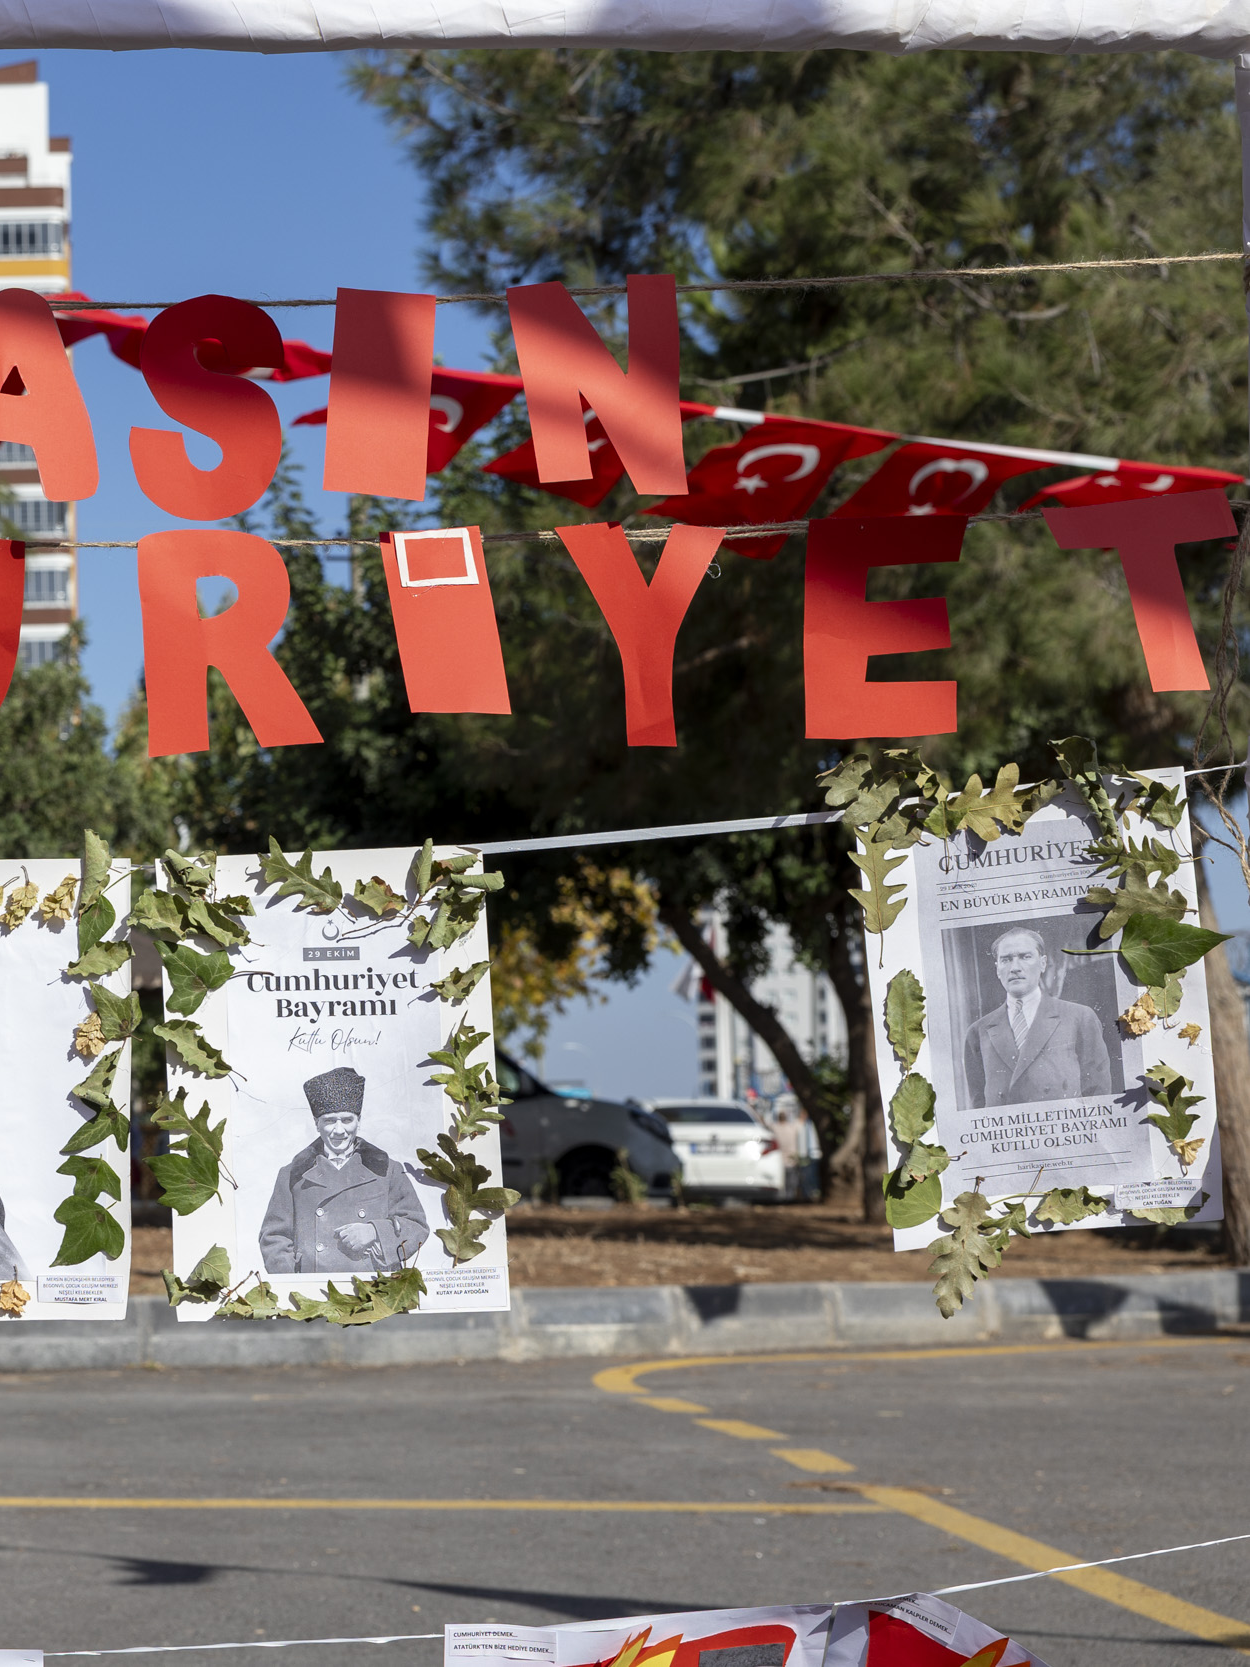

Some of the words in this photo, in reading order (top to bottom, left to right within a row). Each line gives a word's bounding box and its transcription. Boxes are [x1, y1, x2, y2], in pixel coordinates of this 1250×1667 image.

[938, 839, 1095, 872] CUMHURİYE
[940, 900, 960, 912] EN
[964, 893, 1011, 910] BÜYÜK
[308, 950, 321, 958] 29
[327, 948, 356, 958] EKİM
[247, 967, 420, 996] Cumhuriyet
[275, 998, 398, 1024] Bayramı
[288, 1026, 326, 1054] Kutlu
[330, 1028, 381, 1054] Olsun!
[970, 1115, 1004, 1130] TÜM
[1007, 1104, 1113, 1125] MİLLETİMİZİN
[960, 1123, 1058, 1144] CUMHURİYET
[1061, 1117, 1128, 1134] BAYRAMI
[991, 1138, 1040, 1154] KUTLU
[1043, 1133, 1098, 1148] OLSUN!
[905, 1609, 929, 1622] KALPLER
[453, 1630, 491, 1638] CUMHURİYET
[494, 1642, 506, 1650] BİZE
[507, 1644, 528, 1652] HEDİYE
